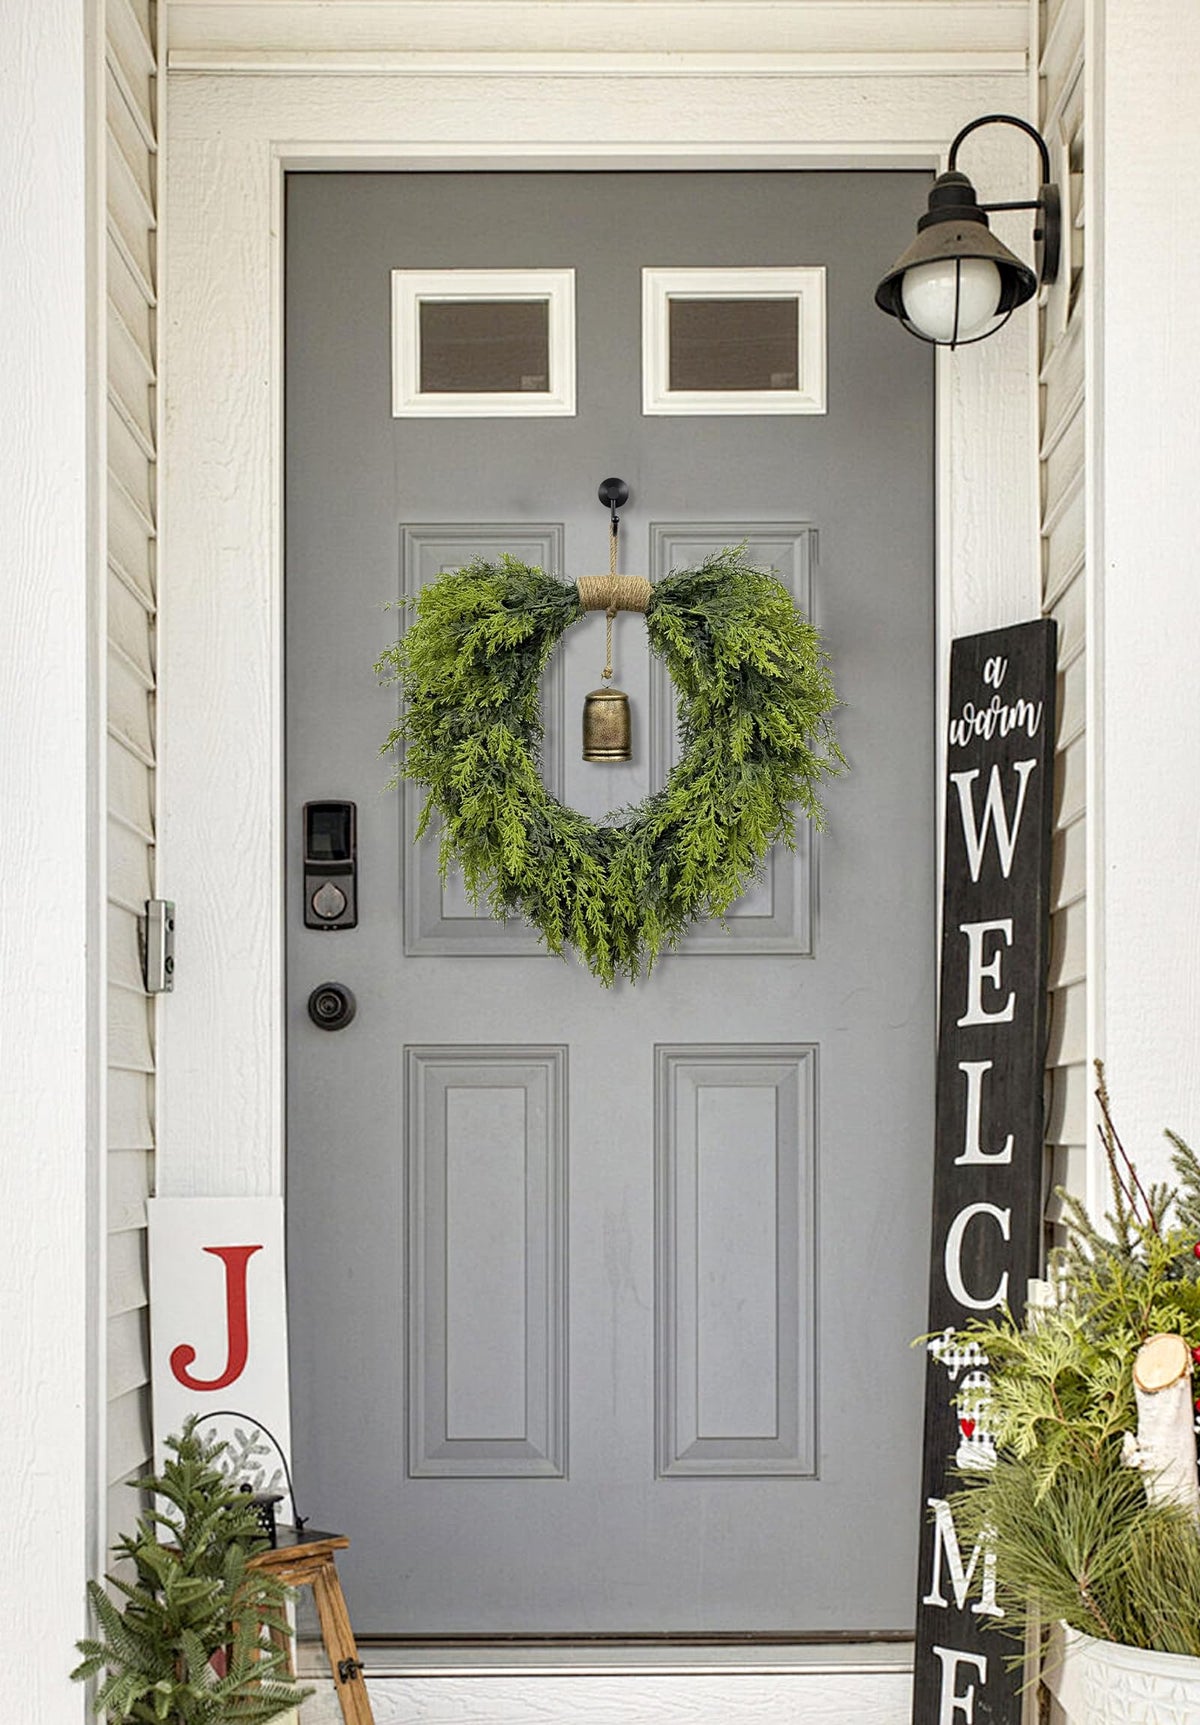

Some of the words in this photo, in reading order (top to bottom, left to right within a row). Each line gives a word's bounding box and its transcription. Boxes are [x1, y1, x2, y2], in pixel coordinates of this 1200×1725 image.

[984, 656, 1008, 689] a
[950, 695, 1043, 747] warm
[169, 1246, 264, 1391] J
